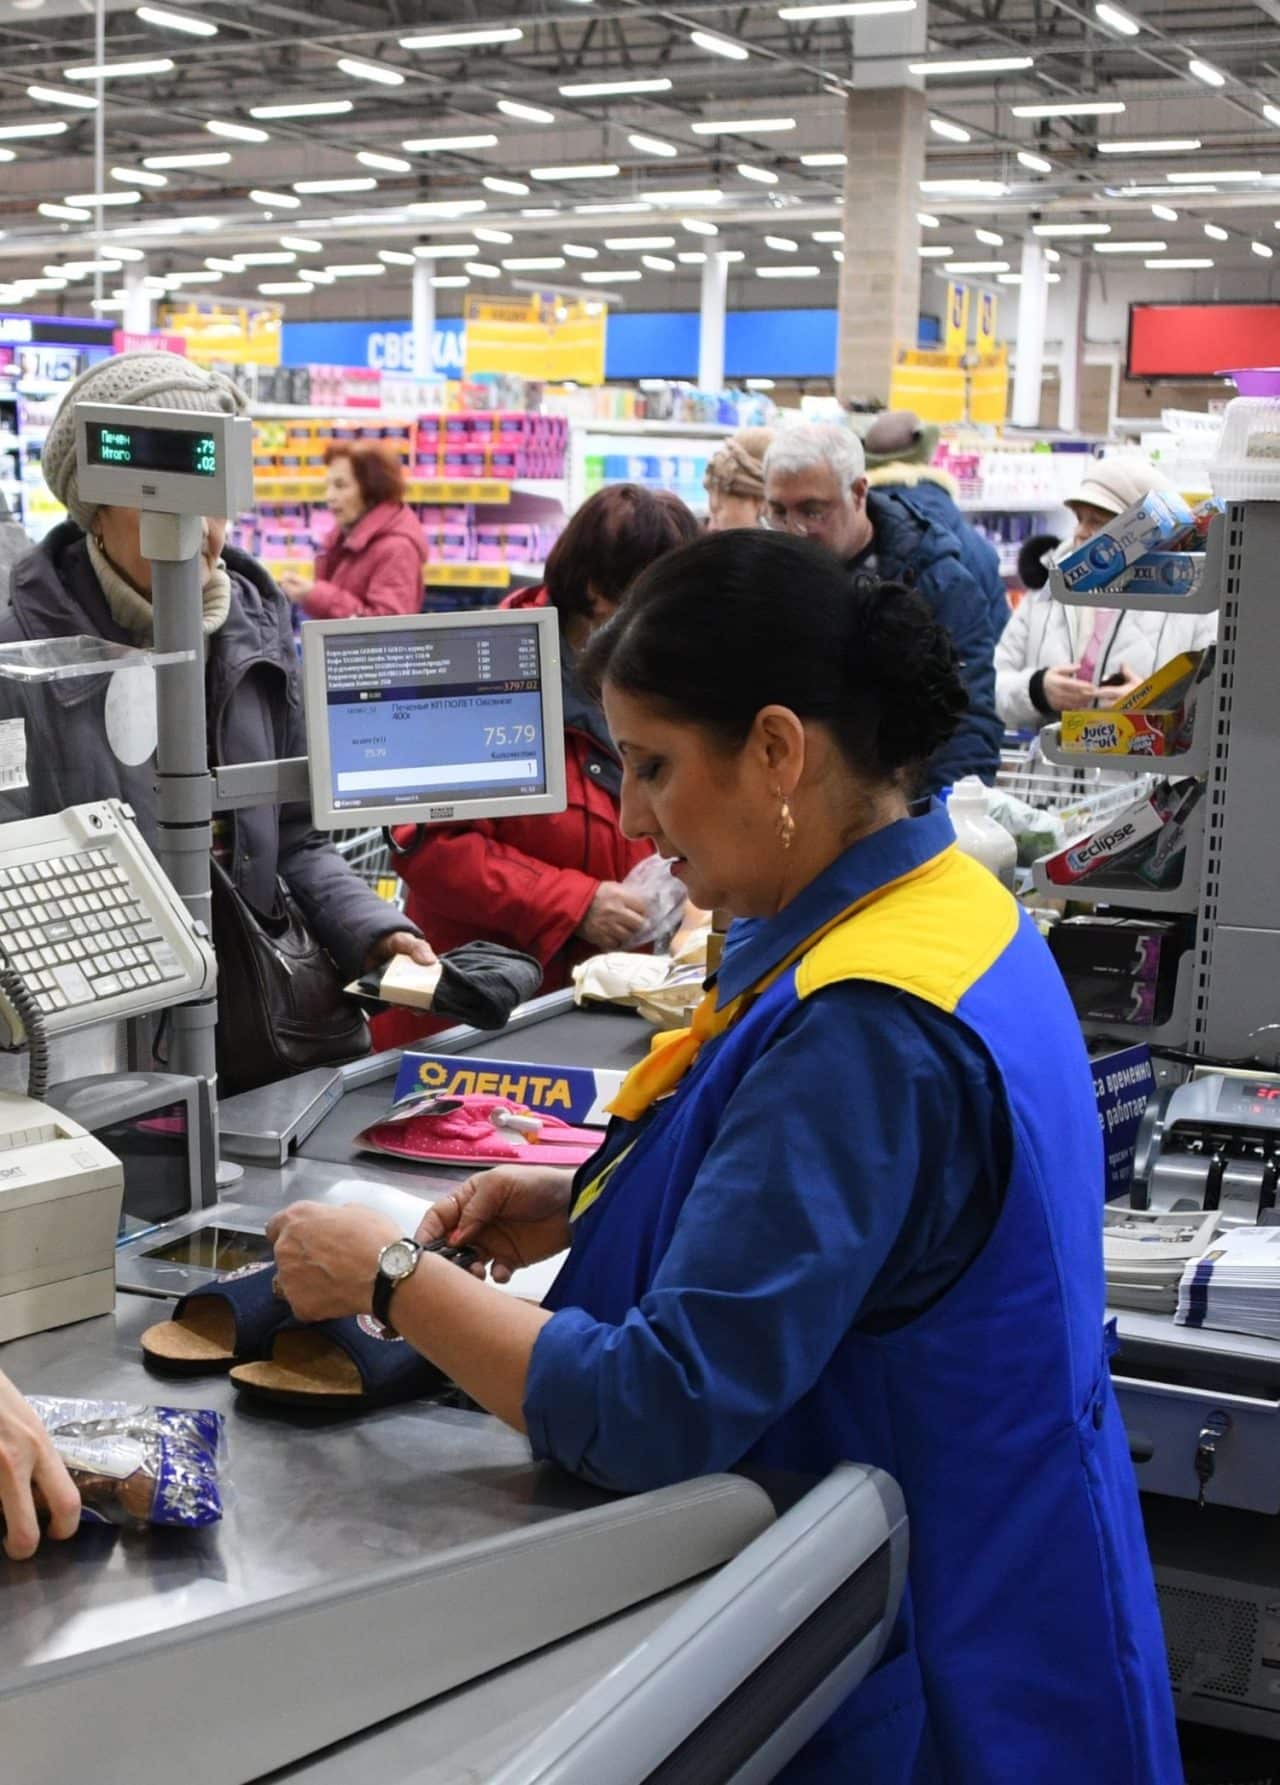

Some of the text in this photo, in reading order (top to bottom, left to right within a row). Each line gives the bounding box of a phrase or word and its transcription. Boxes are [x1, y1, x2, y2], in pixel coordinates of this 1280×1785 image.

[1068, 562, 1091, 584] XXL
[1133, 566, 1155, 579] XXL
[483, 724, 537, 747] 75.79
[1081, 723, 1117, 741] Juicy
[1077, 822, 1137, 864] eclipse
[1130, 935, 1151, 975] 5
[1125, 981, 1146, 1021] 5
[446, 1070, 573, 1109] ЛЕНТА
[1105, 1060, 1152, 1097] временно
[1105, 1095, 1148, 1134] работает
